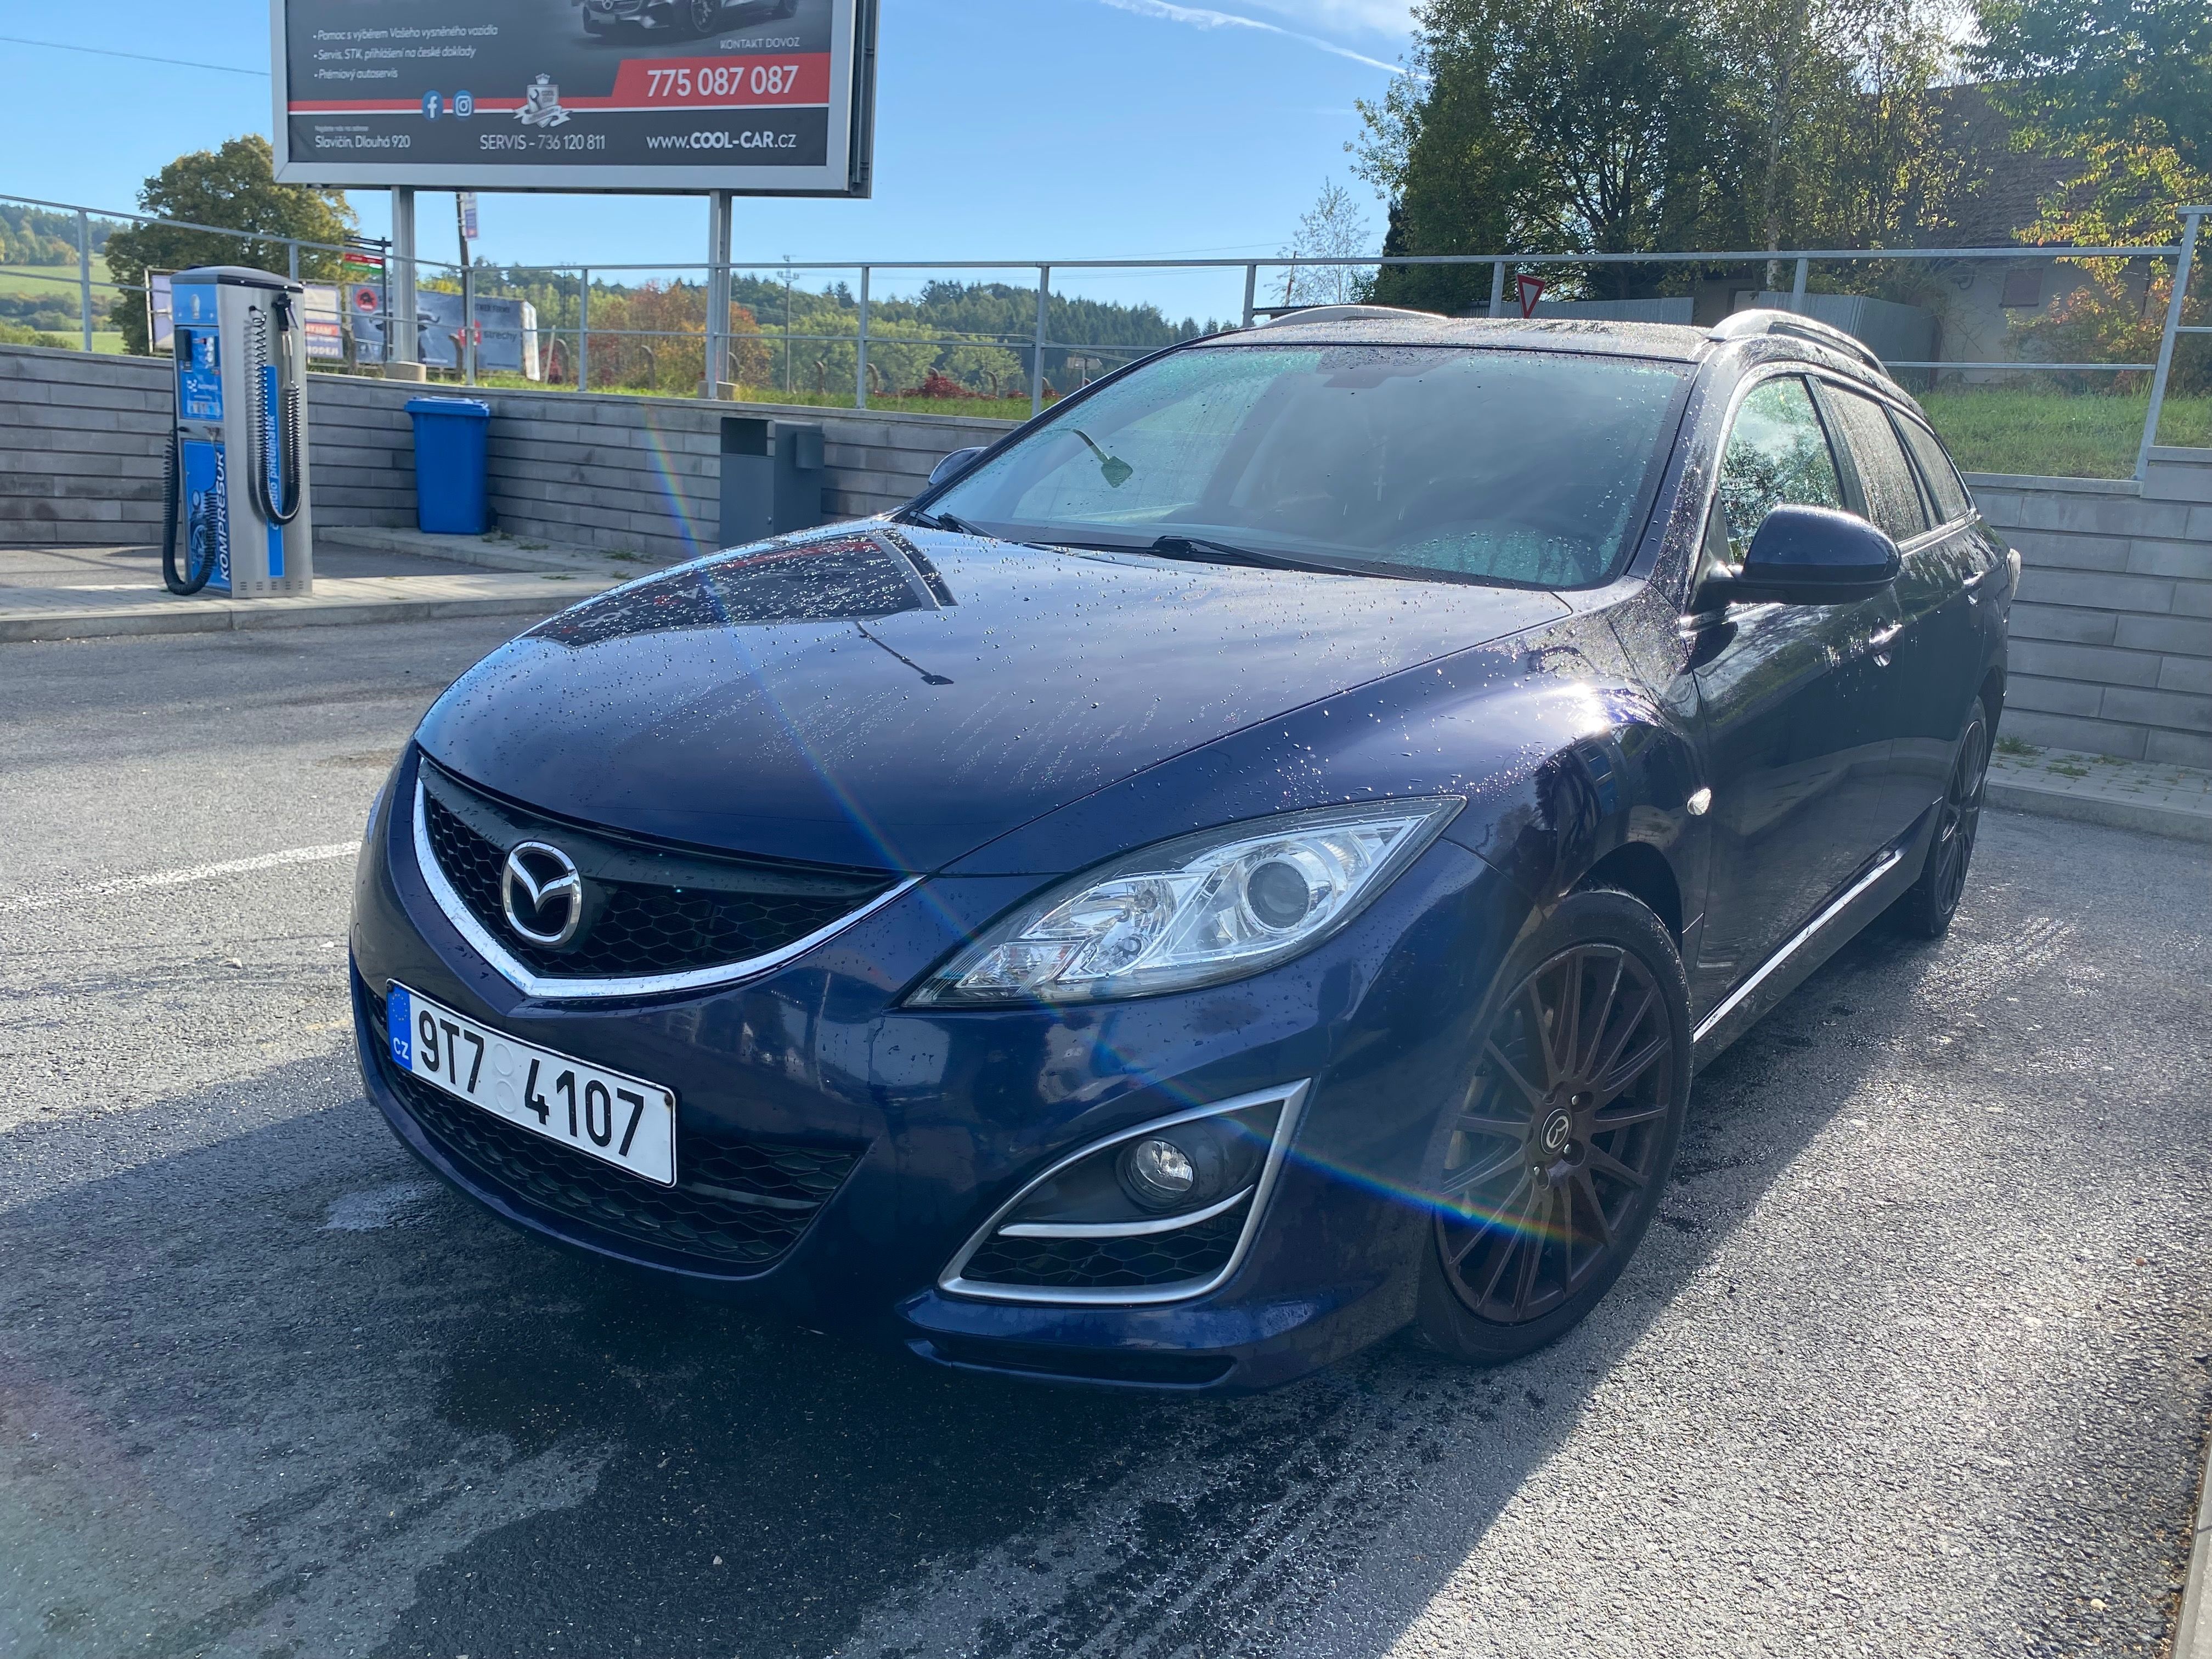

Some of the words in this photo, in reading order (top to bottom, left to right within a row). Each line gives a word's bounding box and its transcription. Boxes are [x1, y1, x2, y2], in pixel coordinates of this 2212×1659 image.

[317, 30, 346, 41] Pomoc
[720, 39, 764, 50] KONTAKT
[765, 37, 800, 48] DOVOZ
[405, 49, 416, 58] na
[356, 67, 399, 79] autoservis
[647, 69, 692, 97] 775
[697, 67, 745, 96] 087
[750, 65, 799, 95] 087
[355, 134, 391, 148] Dlouhá
[391, 134, 411, 148] 920
[479, 134, 527, 150] SERVIS
[538, 134, 561, 150] 736
[562, 134, 585, 150] 120
[586, 134, 606, 150] 811
[393, 1036, 410, 1061] CZ
[418, 1009, 486, 1094] 9T7
[523, 1058, 645, 1158] 4107
